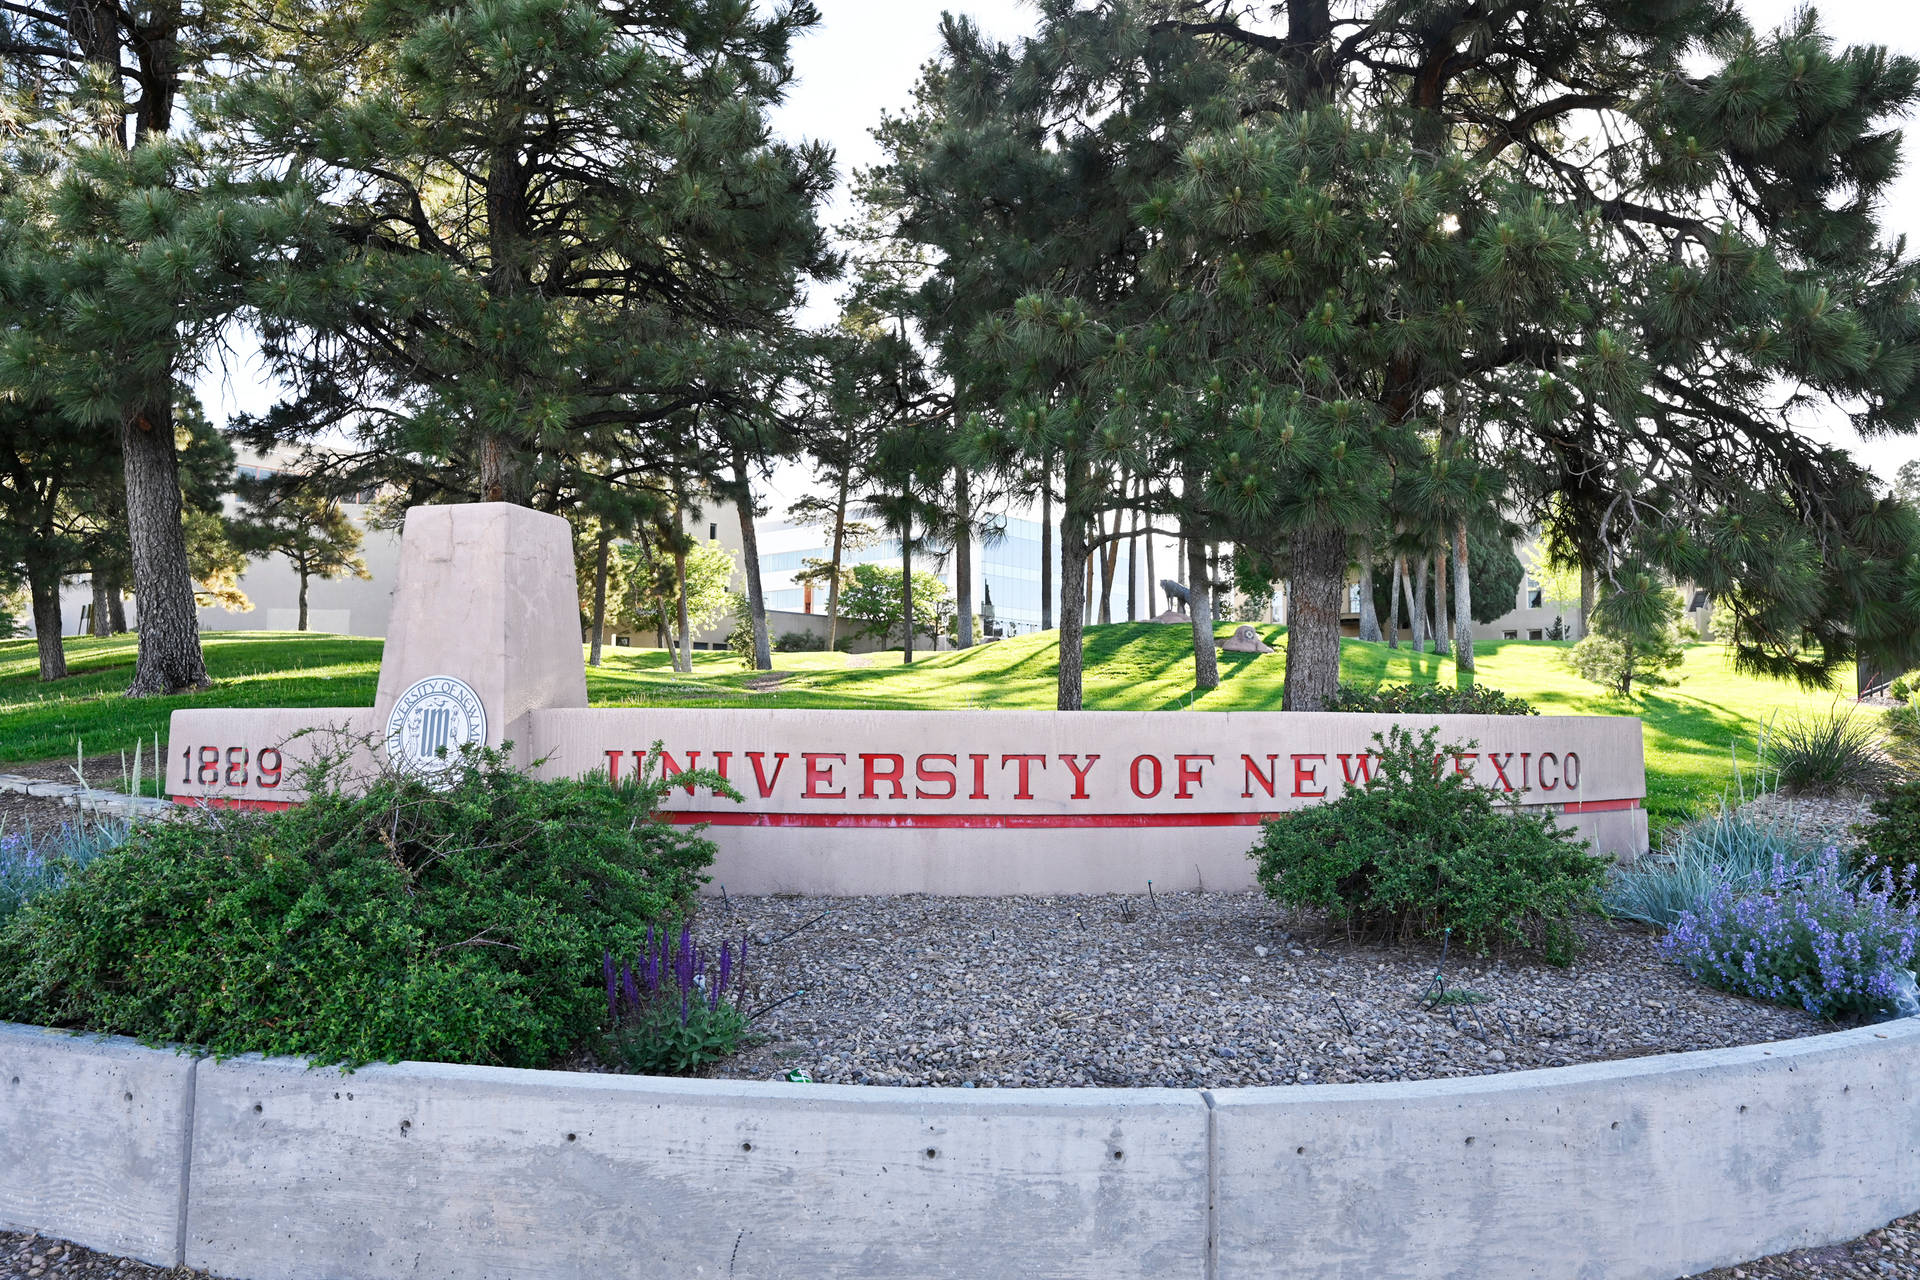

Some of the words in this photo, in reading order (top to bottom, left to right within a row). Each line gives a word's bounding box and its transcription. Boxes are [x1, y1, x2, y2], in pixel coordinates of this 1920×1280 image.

[391, 681, 438, 749] UNIVERSITY
[441, 682, 459, 695] OF
[457, 689, 480, 718] NEW
[183, 745, 283, 788] 1889
[605, 750, 1101, 800] UNIVERSITY
[1129, 754, 1215, 799] OF
[1240, 752, 1388, 798] NEW
